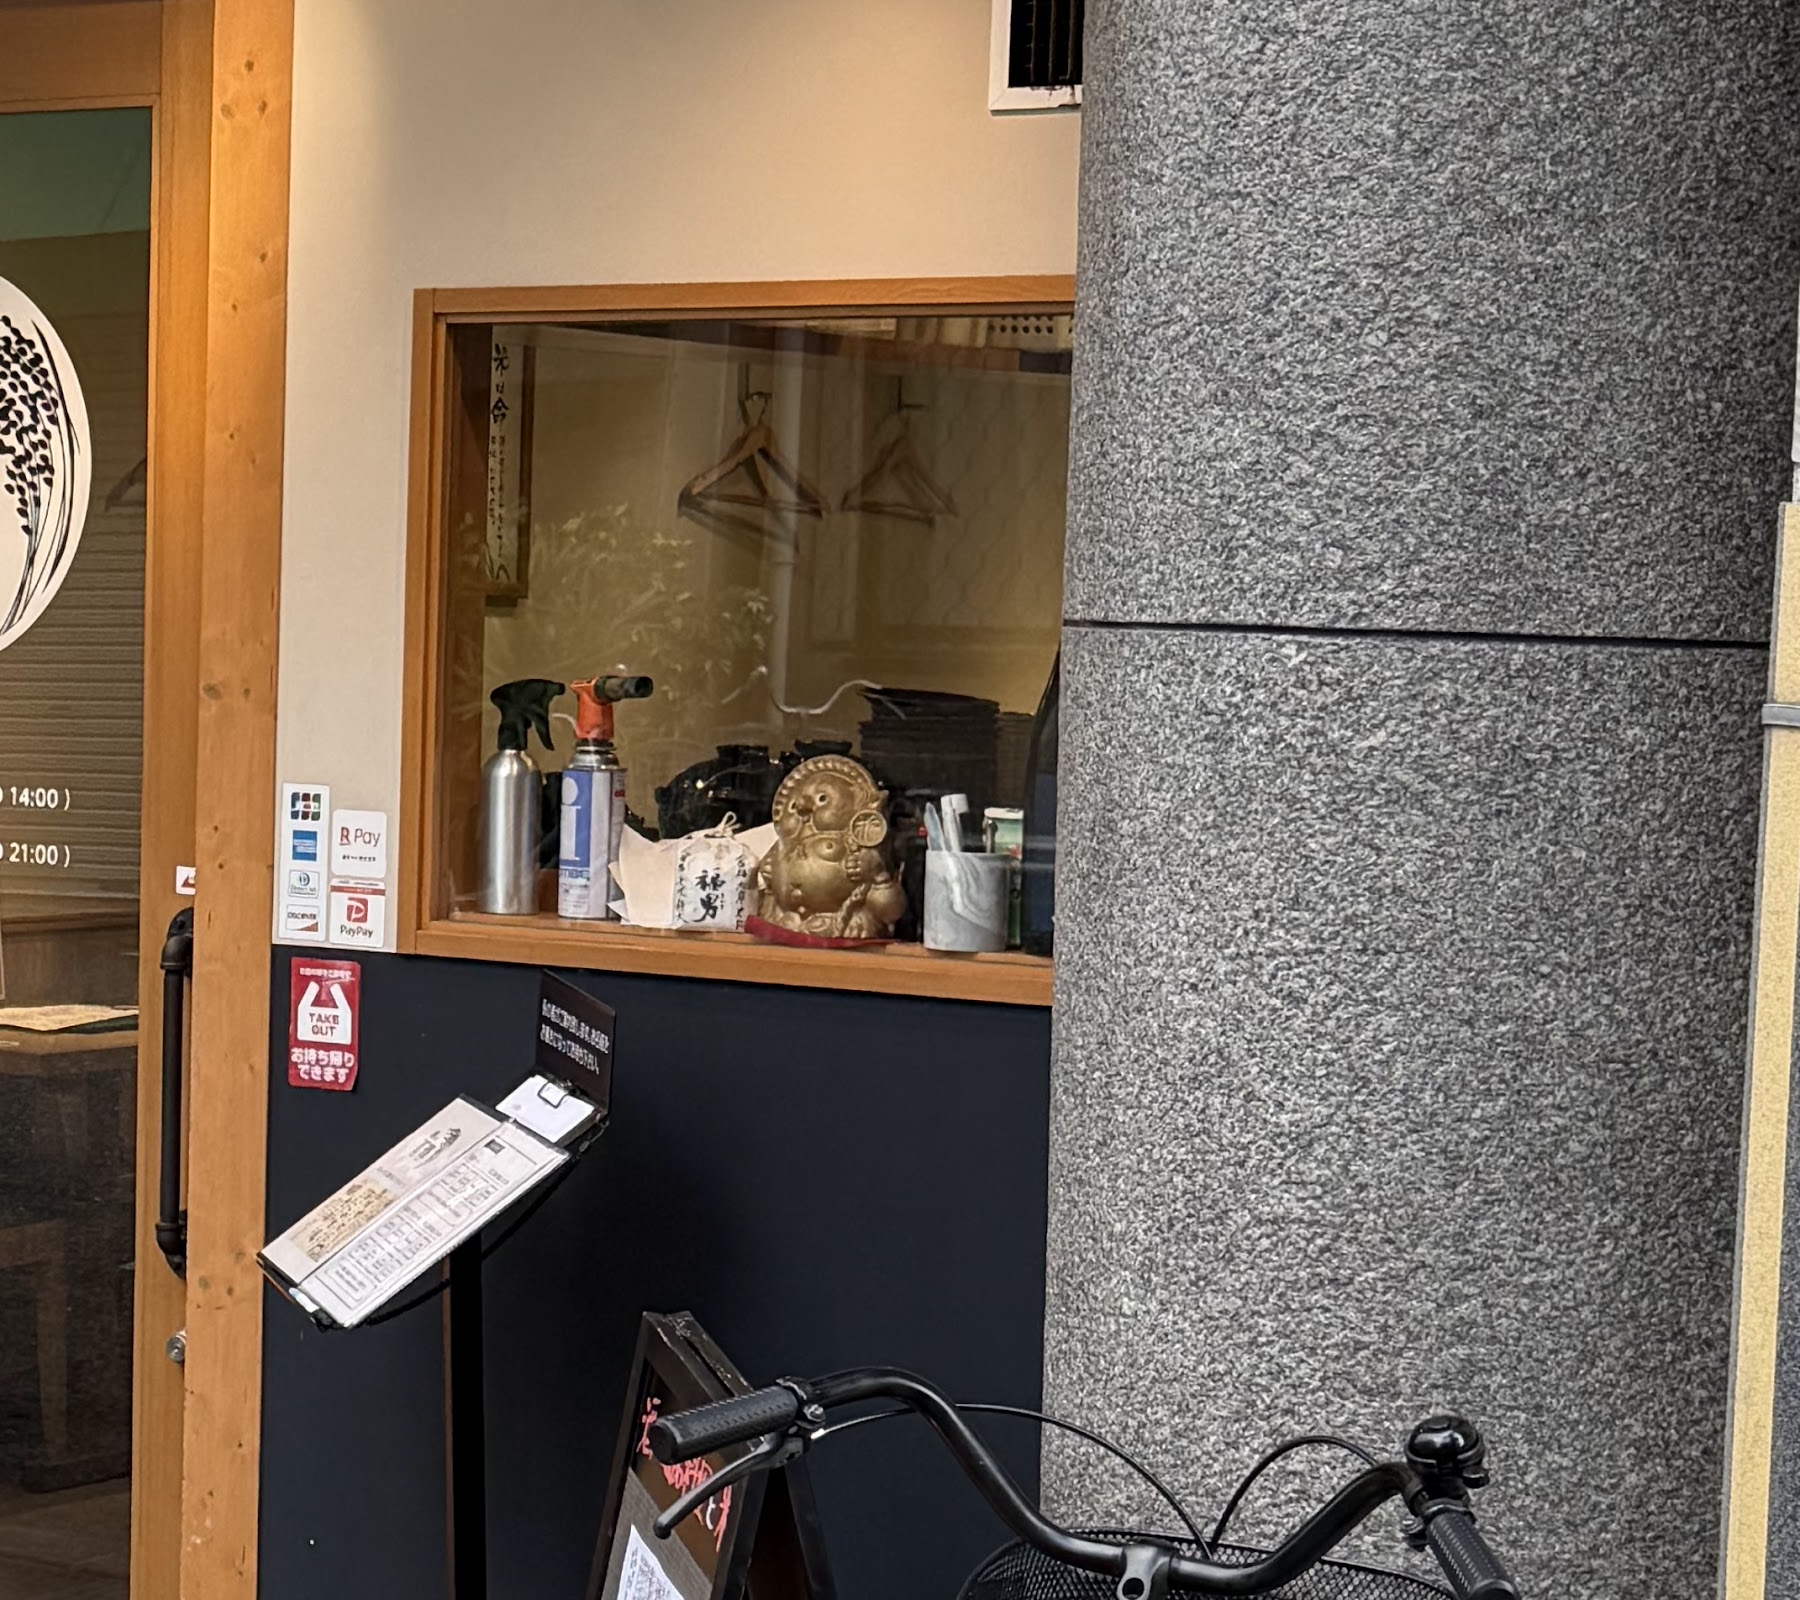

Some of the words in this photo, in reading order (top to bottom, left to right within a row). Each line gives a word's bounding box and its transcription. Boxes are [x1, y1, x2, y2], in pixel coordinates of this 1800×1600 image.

[340, 924, 374, 938] PayPay
[309, 1013, 340, 1025] TAKE
[312, 1025, 336, 1037] OUT
[291, 1048, 354, 1068] お持ち帰り
[298, 1064, 349, 1083] できます
